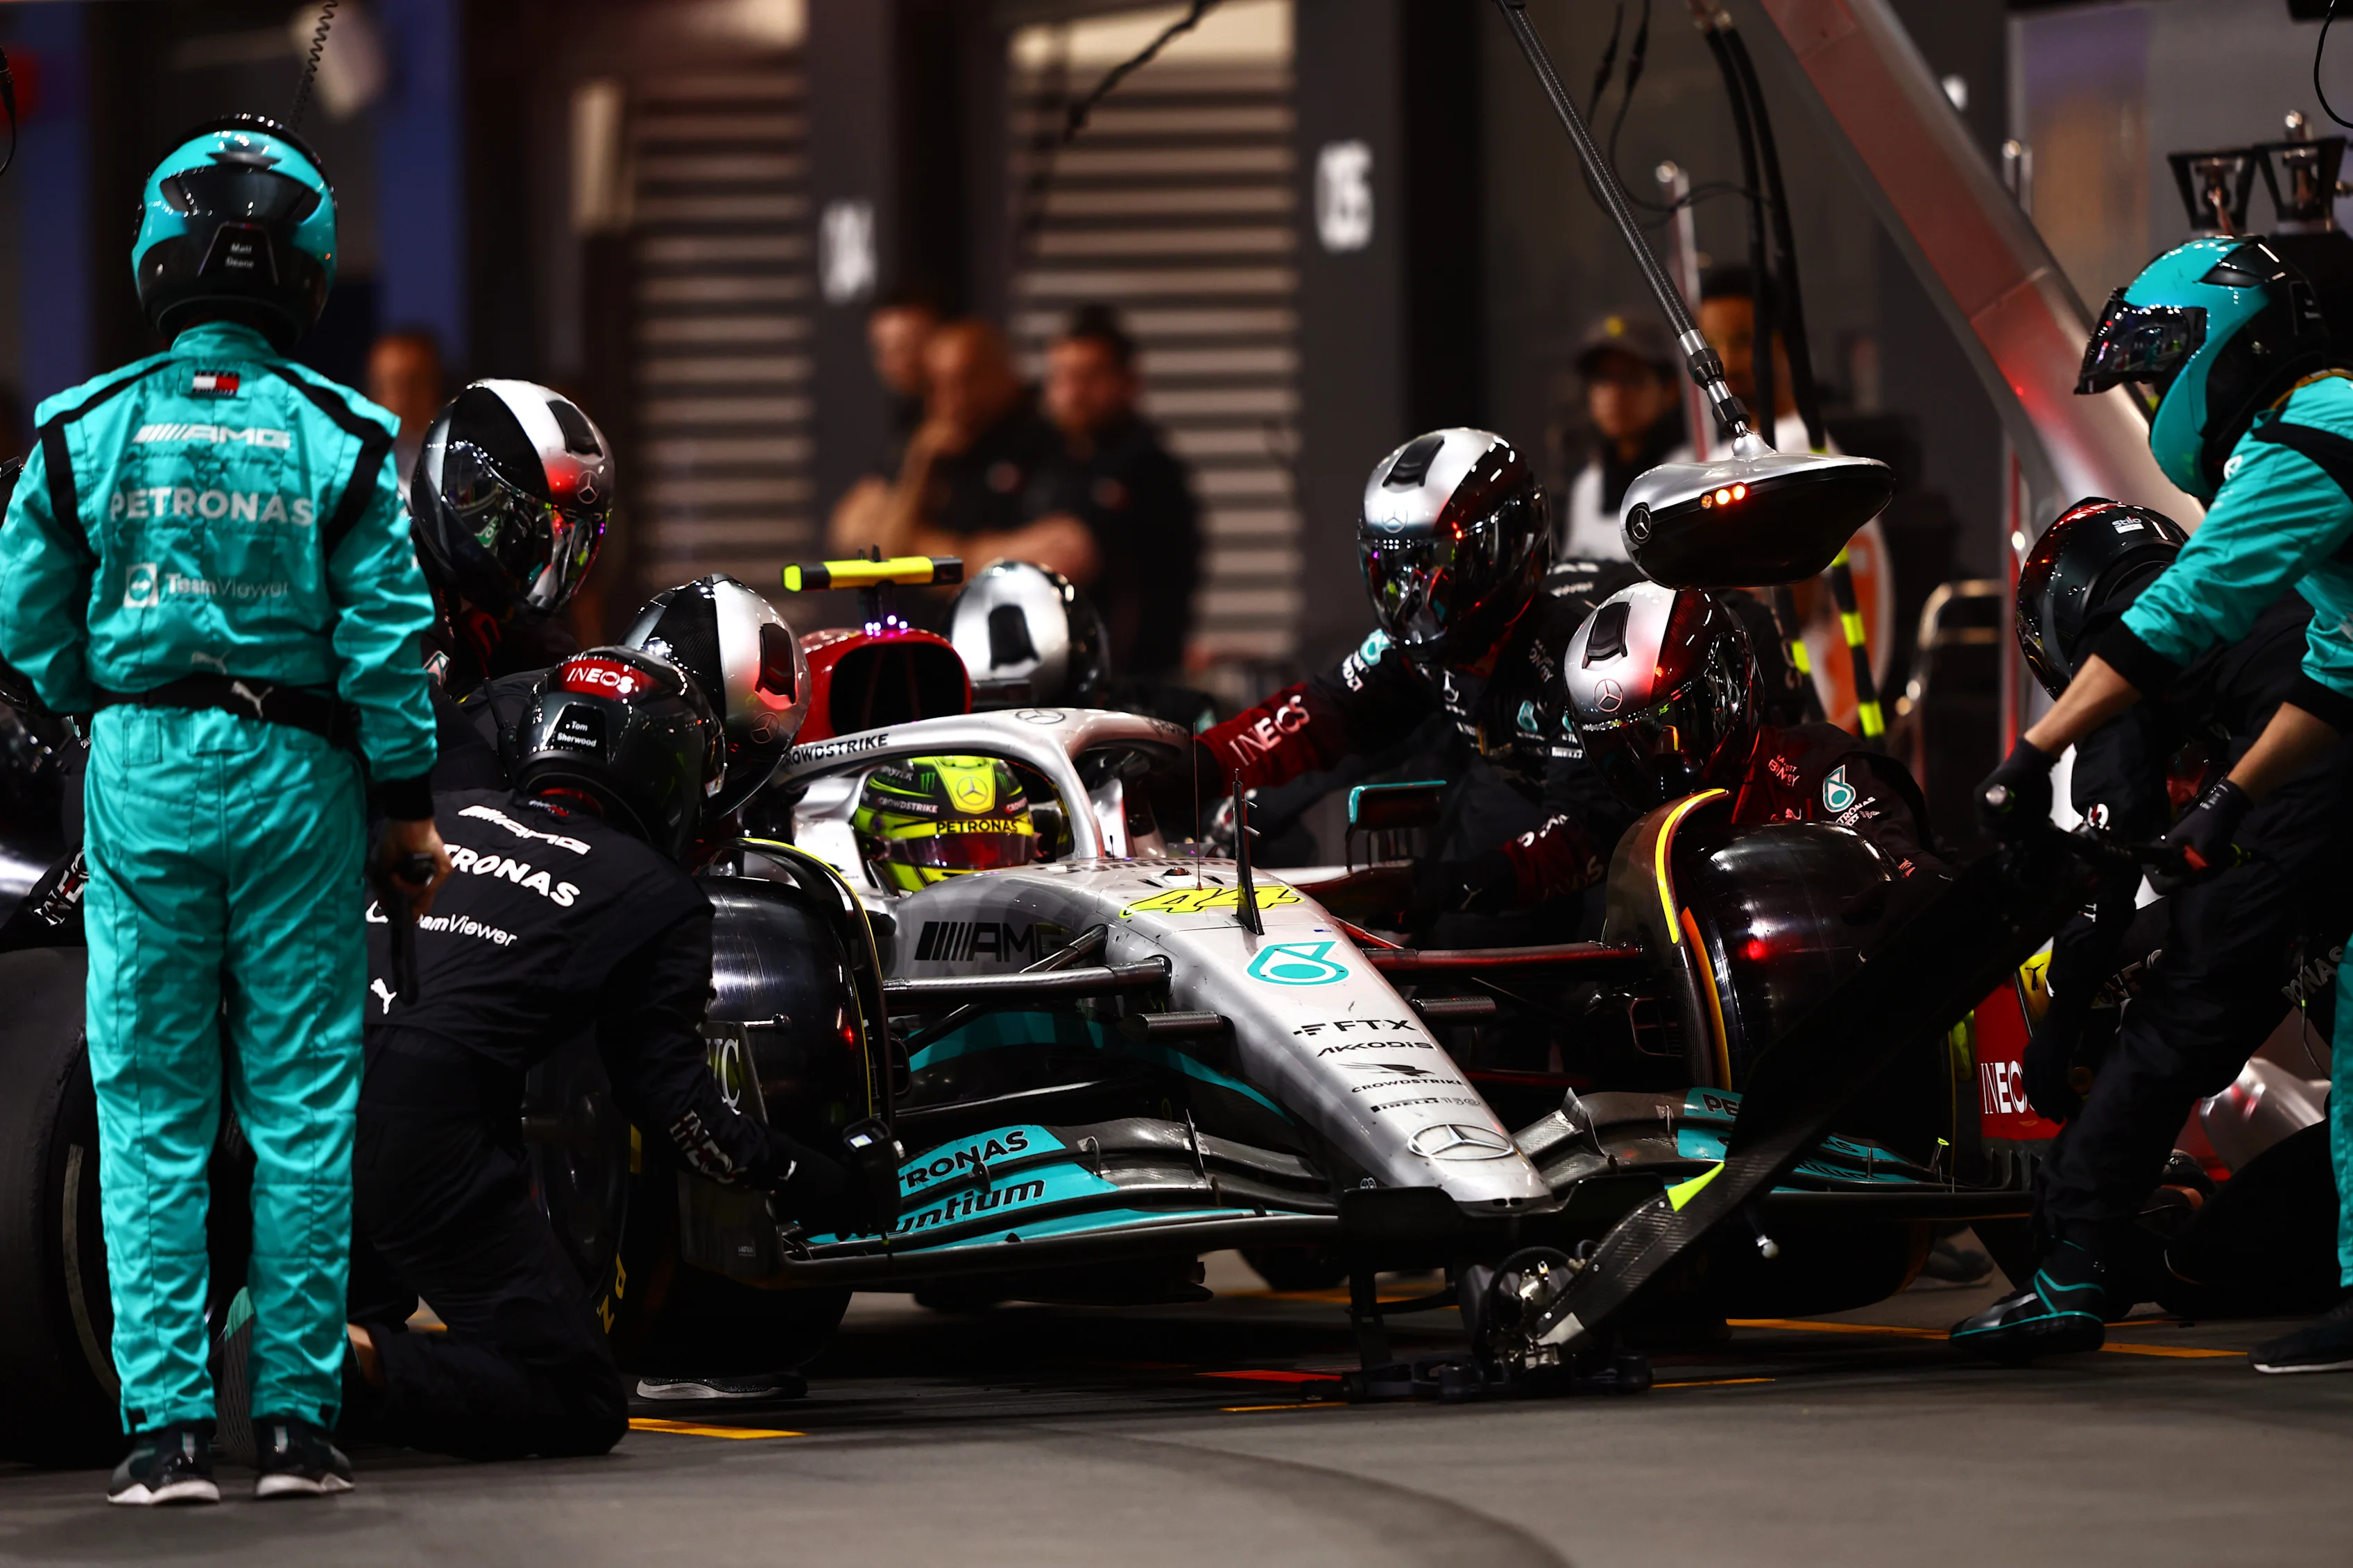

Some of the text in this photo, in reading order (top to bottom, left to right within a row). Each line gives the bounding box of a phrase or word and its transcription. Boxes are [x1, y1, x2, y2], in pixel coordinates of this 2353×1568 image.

[182, 423, 291, 450] AMG
[110, 486, 314, 527] PETRONAS
[165, 574, 288, 598] TeamViewer
[566, 667, 635, 694] INEOS
[557, 732, 597, 748] Sherwood
[572, 721, 588, 732] Tom
[1229, 694, 1310, 766] INEOS
[786, 733, 889, 766] ROWDSTRIKE
[879, 796, 939, 813] CROWDSTRIKE
[1835, 796, 1876, 824] TRONAS
[487, 811, 591, 856] AMG
[937, 820, 1018, 833] PETRONAS
[443, 843, 581, 907] TRONAS
[1118, 886, 1305, 919] 44
[418, 913, 517, 947] amViewer
[966, 922, 1063, 963] AMG
[1333, 1019, 1418, 1032] FTX
[1980, 1060, 2035, 1114] INEO
[900, 1130, 1029, 1189] RONAS
[888, 1180, 1045, 1237] yntium
